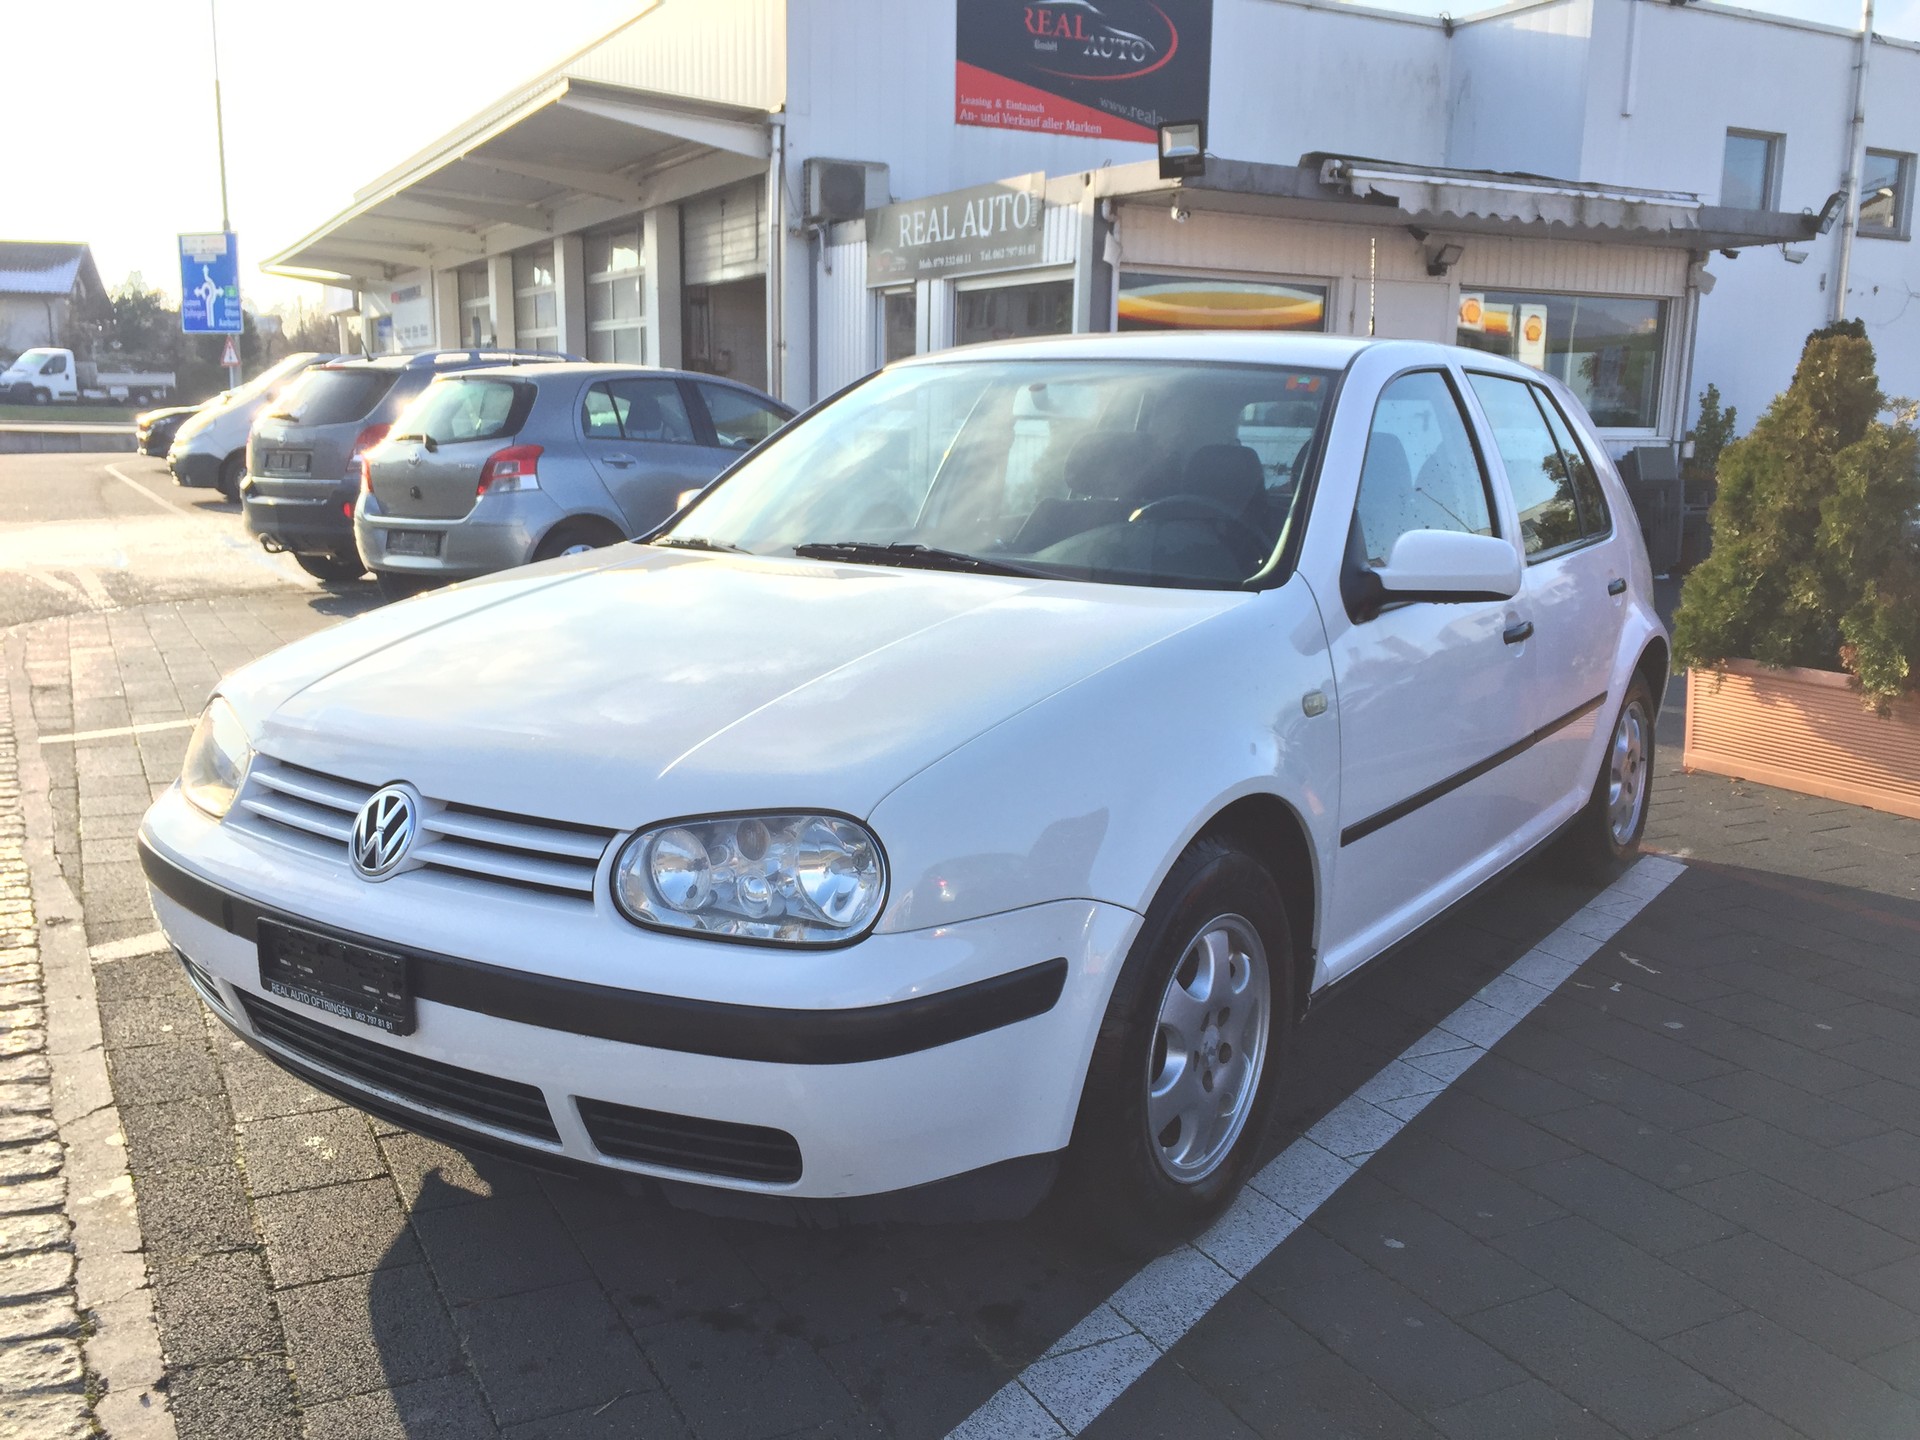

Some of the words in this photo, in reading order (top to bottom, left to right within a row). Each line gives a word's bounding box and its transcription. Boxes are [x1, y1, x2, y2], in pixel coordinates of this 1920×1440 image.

[1024, 7, 1089, 41] REAL
[1083, 34, 1146, 62] AUTO
[960, 95, 992, 109] Leasing
[995, 99, 1002, 108] &
[1005, 100, 1045, 113] Eintausch
[1099, 97, 1168, 126] www.reala
[959, 108, 978, 120] An-
[980, 112, 1000, 123] und
[1002, 112, 1040, 128] Verkauf
[1041, 117, 1064, 130] aller
[1065, 120, 1102, 134] Marken
[898, 205, 956, 248] REAL
[960, 190, 1031, 238] AUTO
[271, 982, 290, 997] REAL
[290, 989, 311, 1005] AUTO
[311, 997, 353, 1018] OFTRINGEN
[386, 1021, 394, 1030] 81
